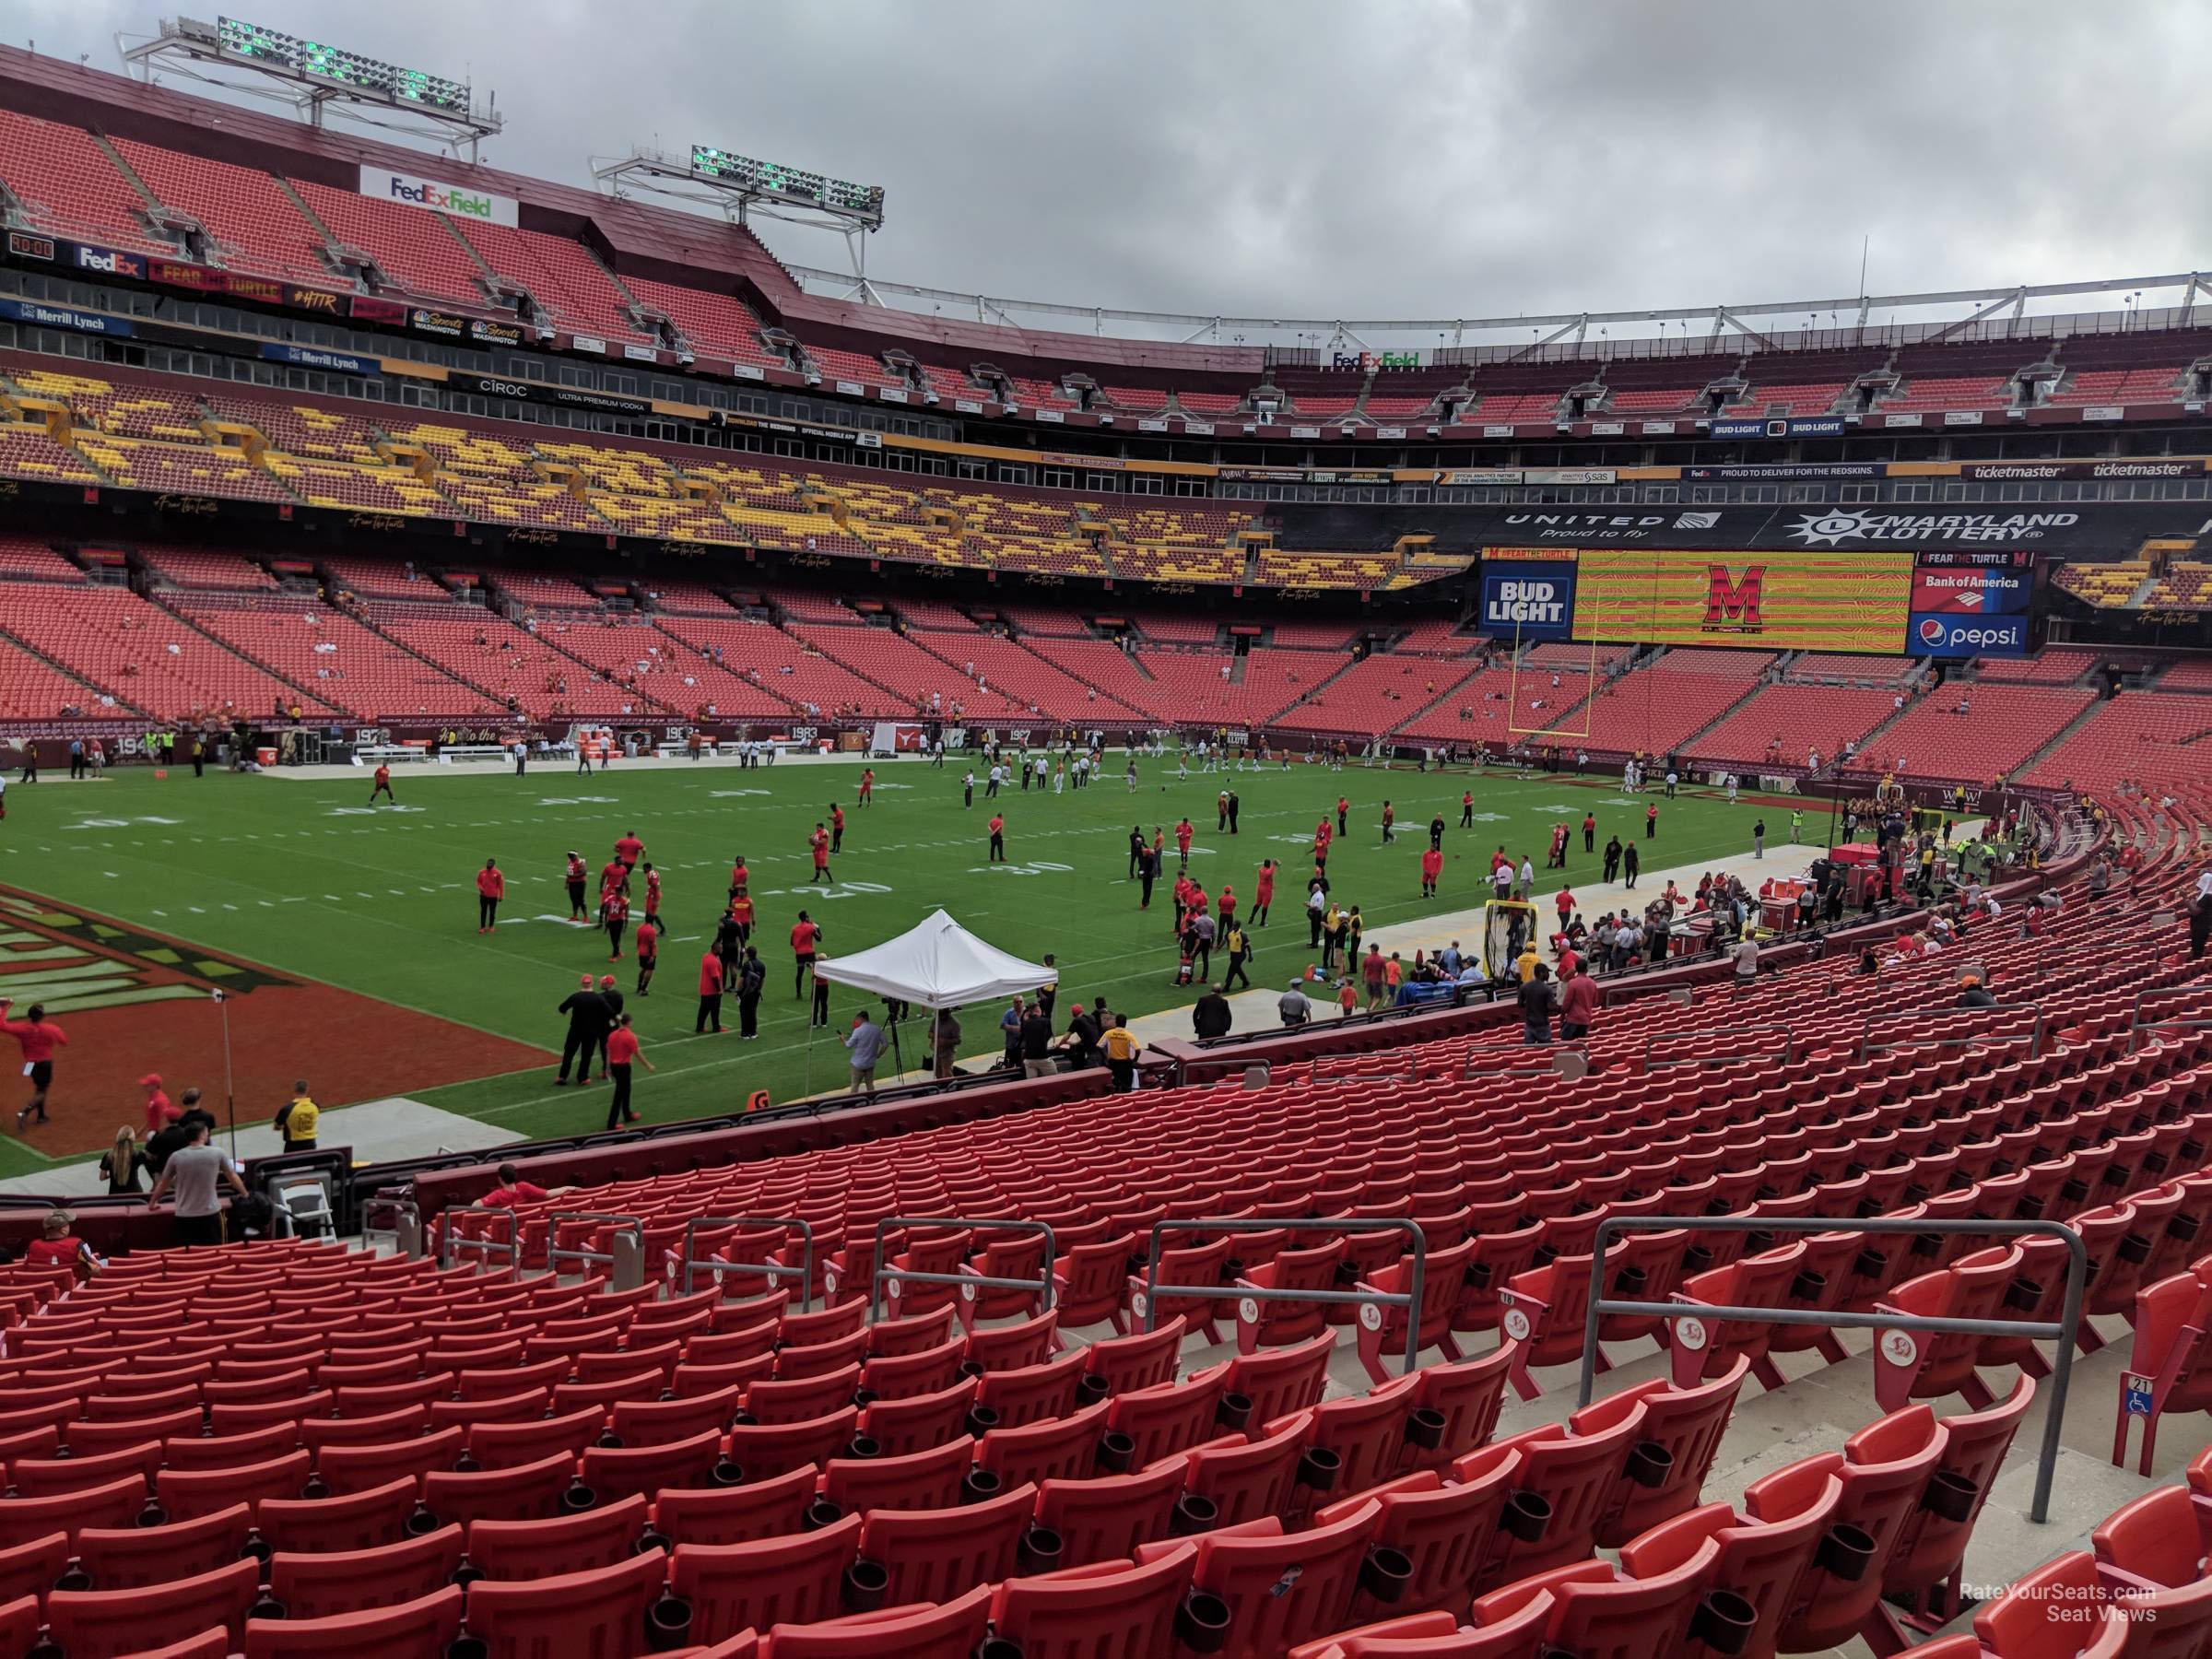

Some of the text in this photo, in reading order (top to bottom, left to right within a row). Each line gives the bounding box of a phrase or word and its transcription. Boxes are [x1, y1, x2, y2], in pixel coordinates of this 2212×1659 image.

[391, 176, 491, 218] FedExField
[80, 247, 138, 276] FedEx
[37, 308, 72, 324] Merrill
[75, 314, 104, 330] Lynch
[428, 312, 464, 328] Sports
[414, 323, 461, 335] WASHINGTON
[486, 324, 521, 338] Sports
[472, 333, 518, 346] WASHINGTON
[302, 351, 331, 365] Merrill
[334, 357, 359, 370] Lynch
[1333, 351, 1419, 369] FedExField
[480, 380, 644, 411] CÎROC ULTRA PREMIUM VODKA
[727, 418, 757, 428] DOWNLOAD
[1735, 425, 1760, 433] LIGHT
[1793, 422, 1841, 432] BUD LIGHT
[802, 428, 825, 437] OFFICIAL
[825, 431, 844, 440] MOBILE
[1592, 472, 1608, 480] sas
[1691, 469, 1711, 477] FedEx
[1721, 469, 1748, 477] PROUD
[1761, 468, 1794, 477] DELIVER
[1813, 467, 1829, 476] THE
[1830, 466, 1874, 476] REDSKINS.
[1974, 465, 2062, 478] ticketmaster
[2093, 463, 2185, 477] ticketmaster
[1504, 515, 1665, 526] UNITED
[1881, 513, 2079, 526] MARYLAND
[1539, 528, 1650, 539] Proud to fly
[1865, 526, 2032, 540] LOTTERY
[1923, 553, 2008, 564] #FEARTHETURTLE
[1925, 576, 2019, 588] Bank of America
[1500, 582, 1555, 602] BUD
[1703, 565, 1768, 626] M
[1488, 601, 1564, 621] LIGHT
[1950, 627, 2017, 648] pepsi
[792, 726, 818, 738] 1983
[1943, 788, 1982, 805] WW!
[790, 881, 893, 899] 20
[2133, 1378, 2149, 1394] 21
